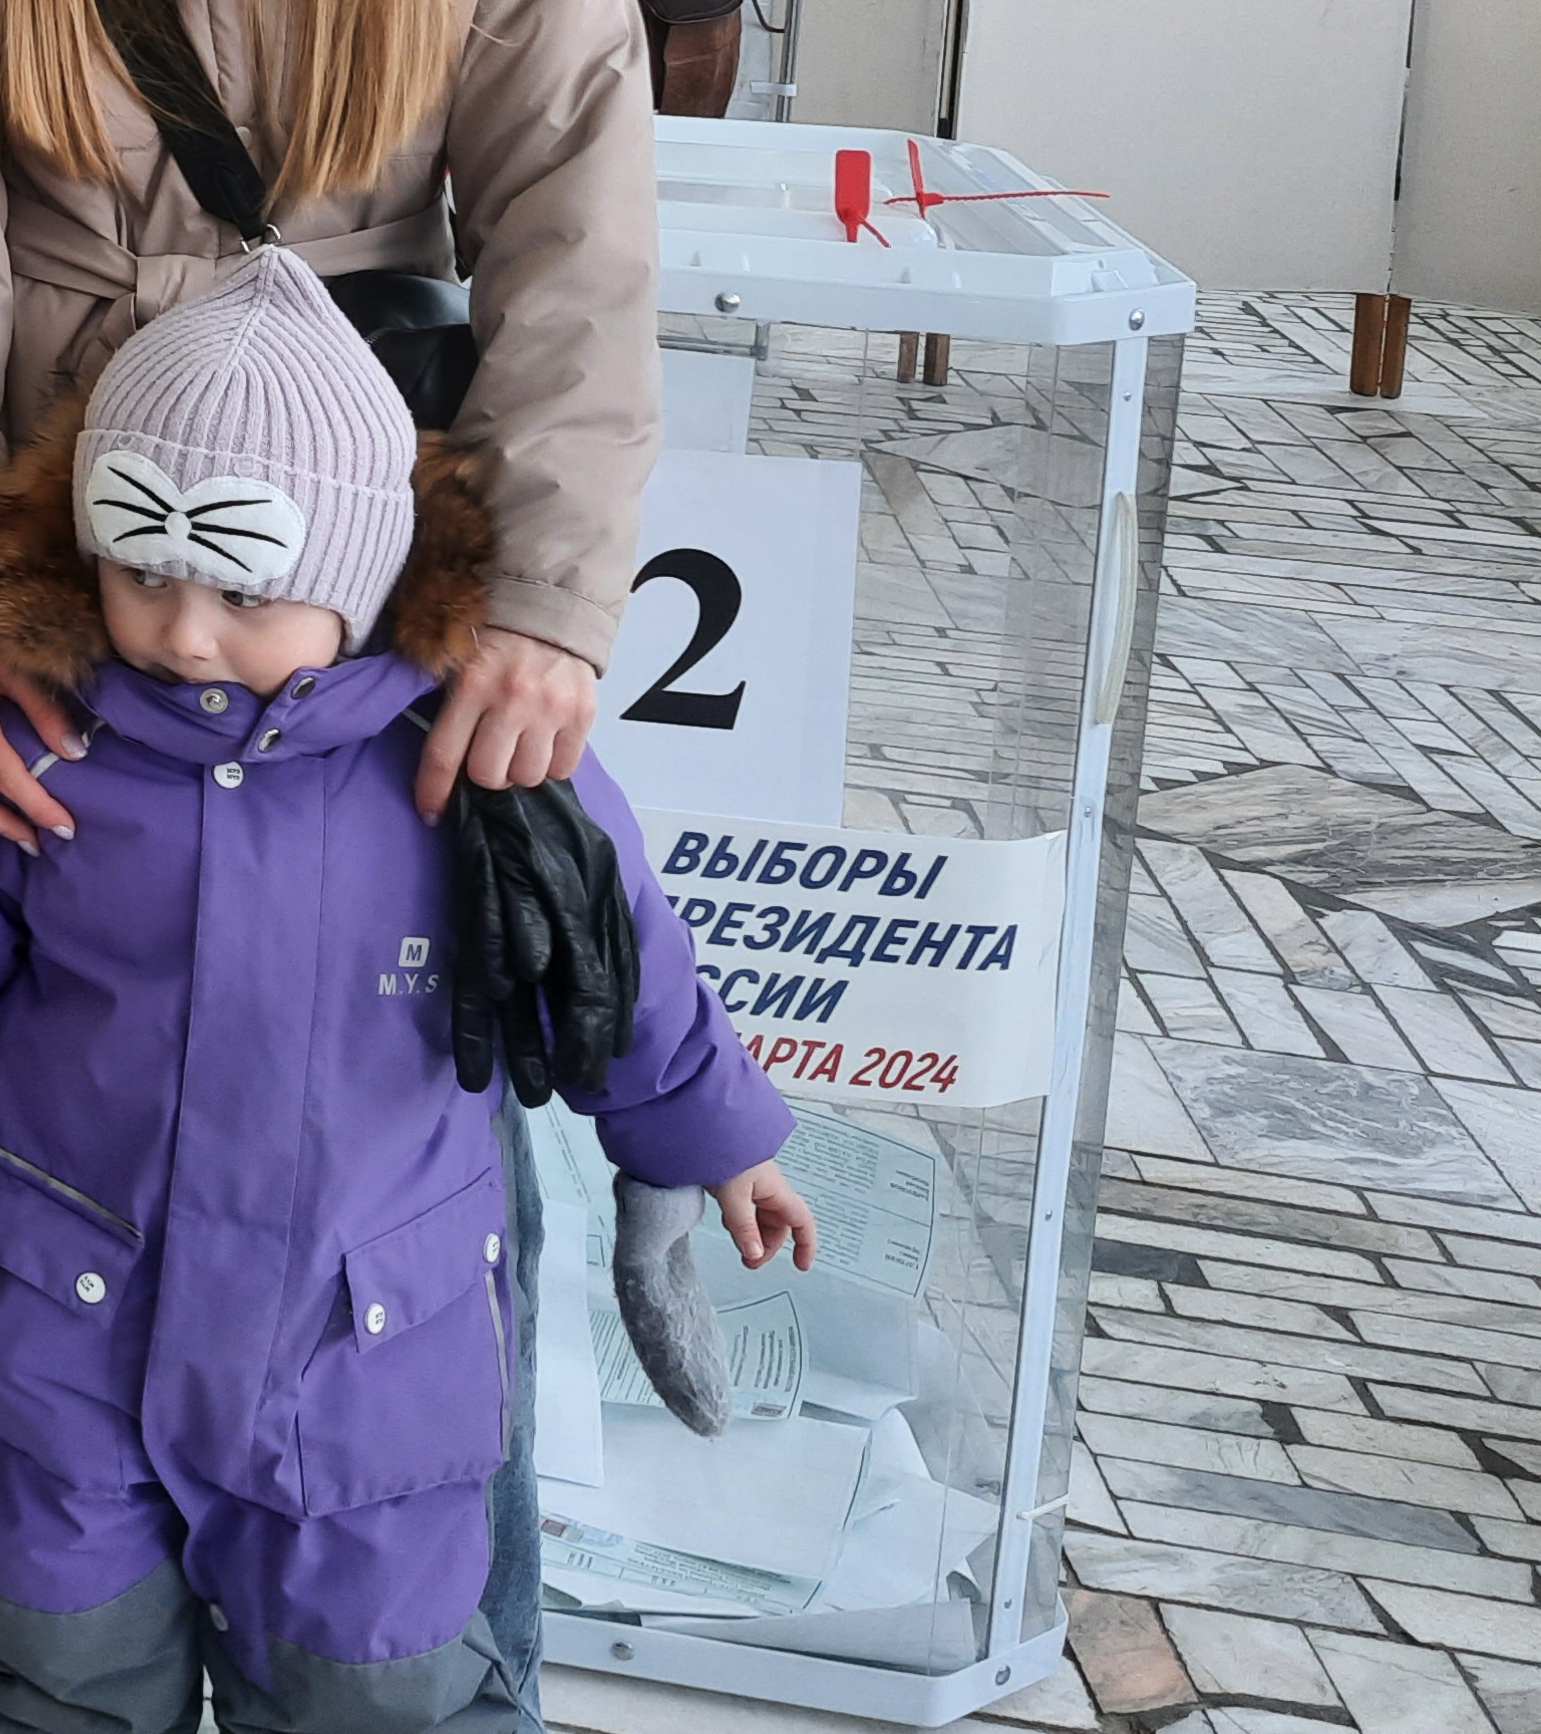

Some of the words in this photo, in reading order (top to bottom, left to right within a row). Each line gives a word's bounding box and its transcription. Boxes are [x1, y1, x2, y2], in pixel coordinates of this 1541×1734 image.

[619, 547, 746, 730] 2
[661, 831, 949, 901] ВЫБОРЫ
[665, 894, 1018, 972] РЕЗИДЕНТА
[736, 1032, 844, 1083] АРТА
[849, 1047, 958, 1094] 2024
